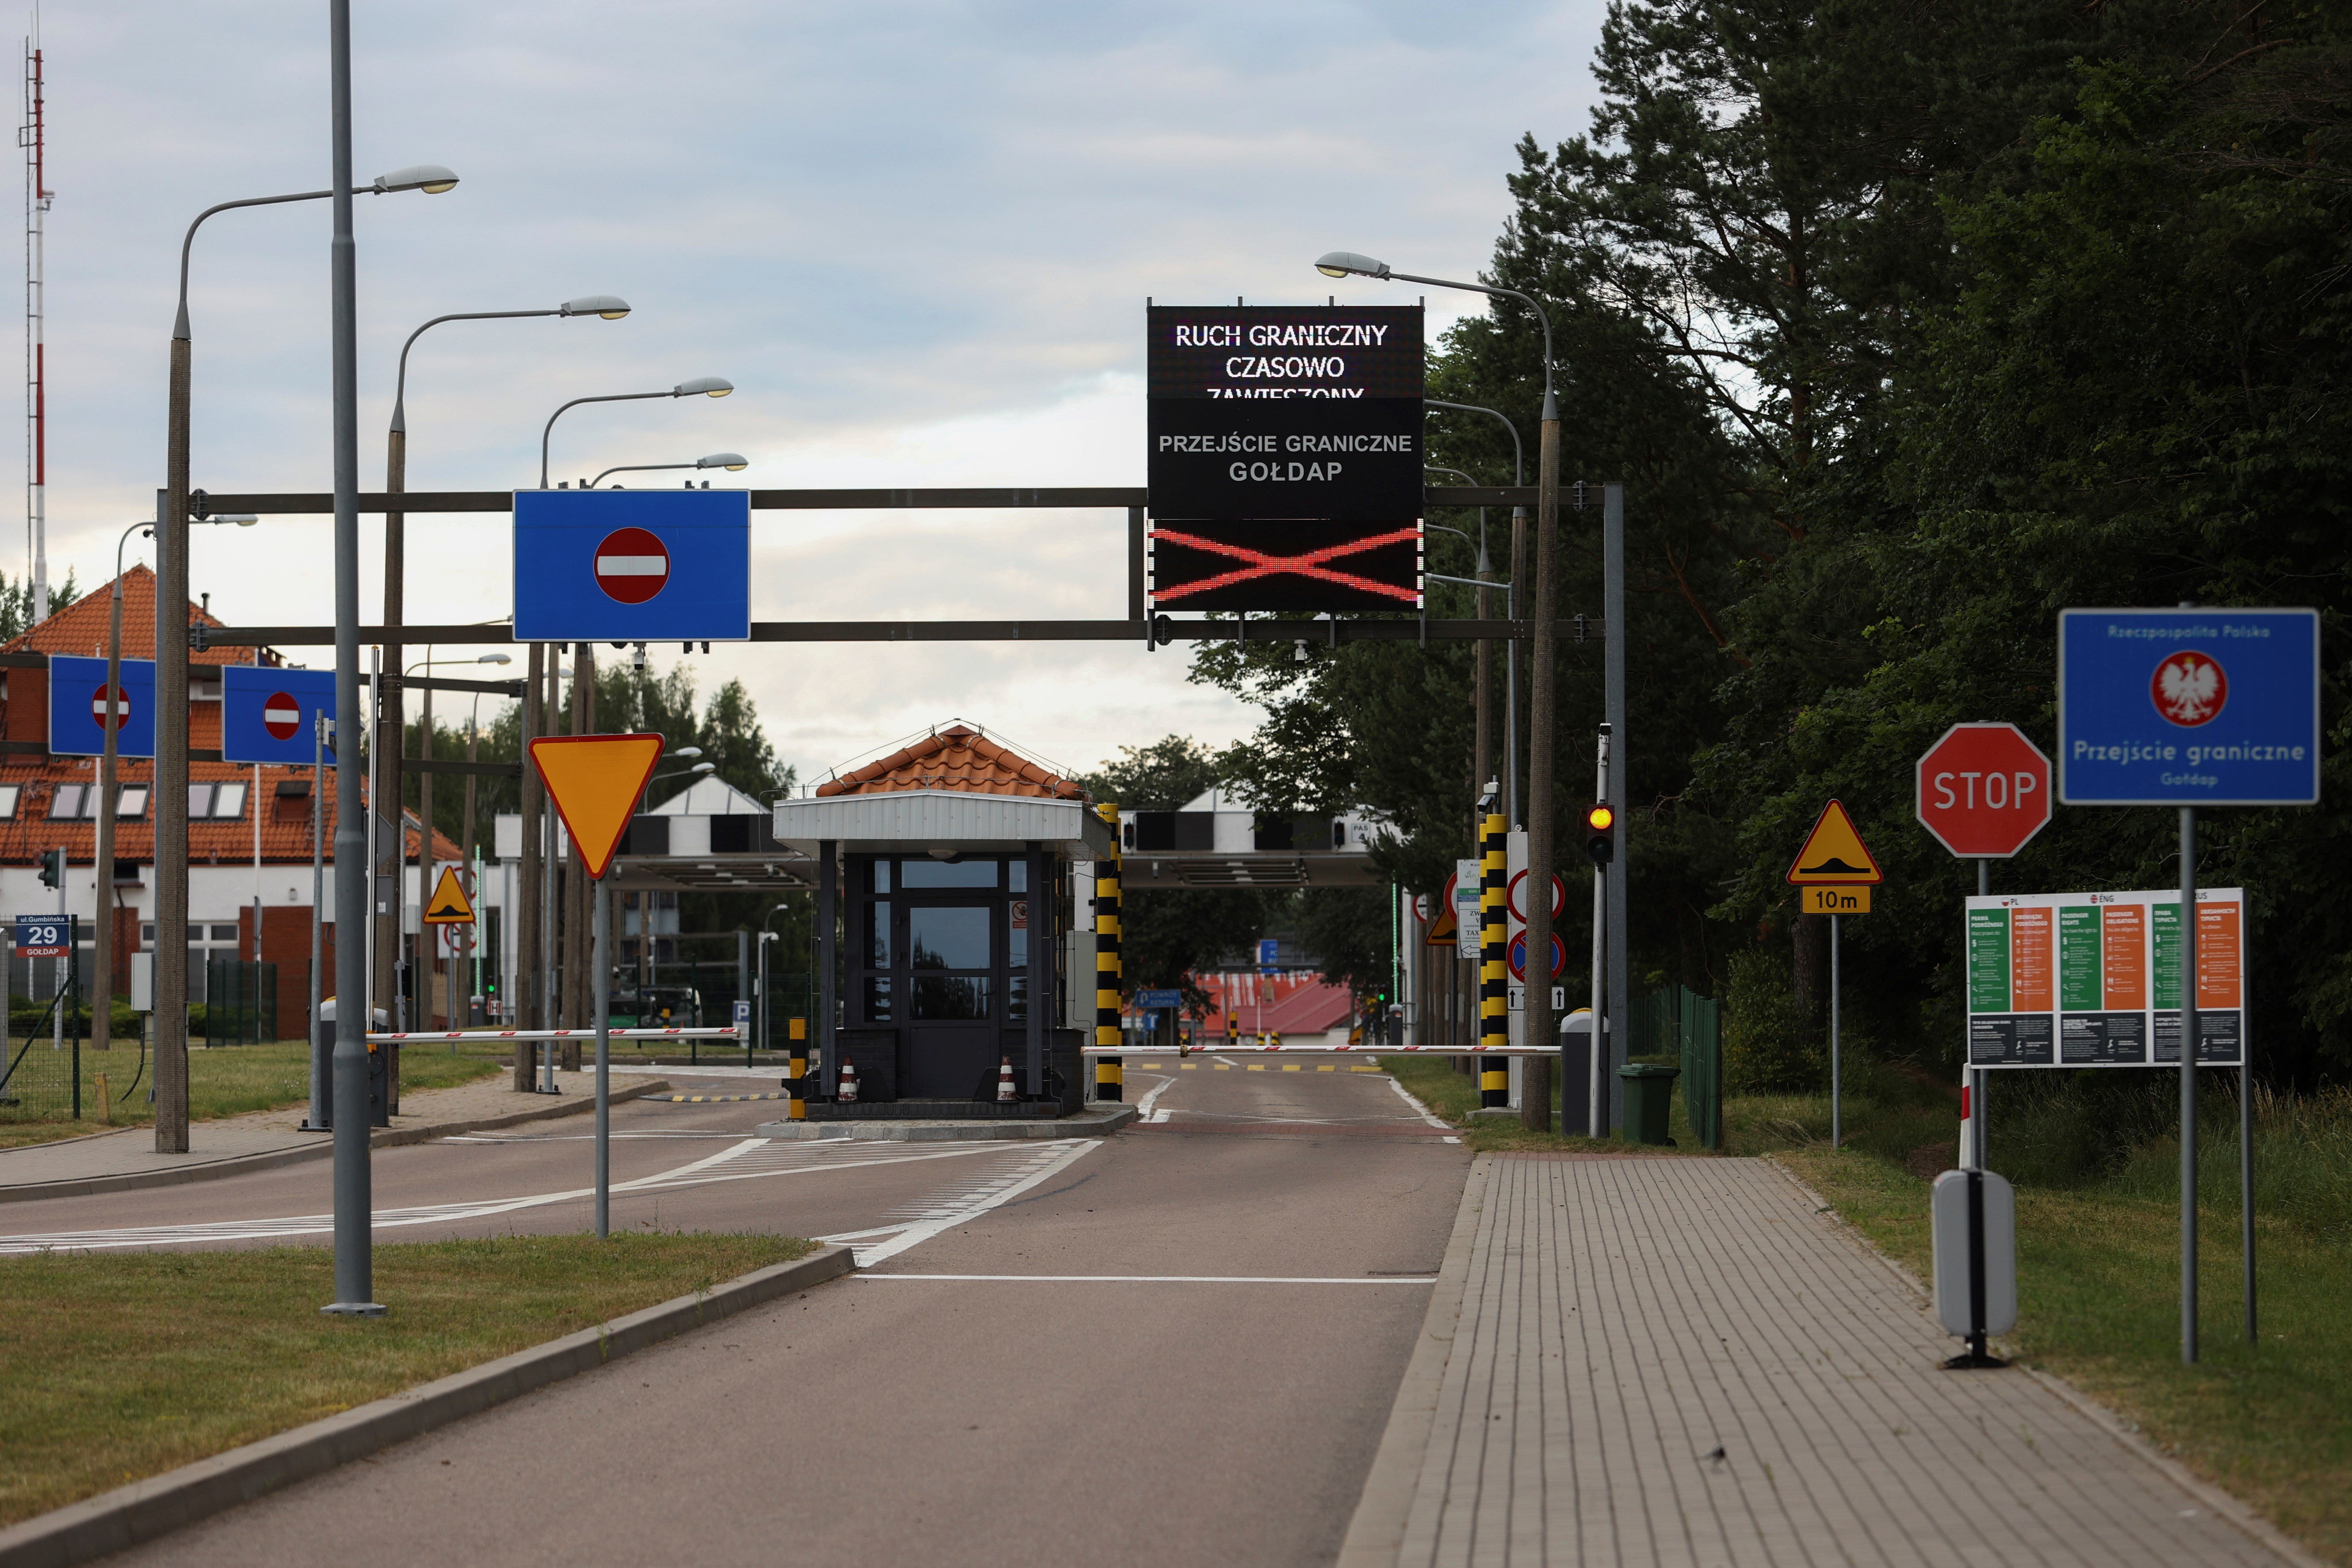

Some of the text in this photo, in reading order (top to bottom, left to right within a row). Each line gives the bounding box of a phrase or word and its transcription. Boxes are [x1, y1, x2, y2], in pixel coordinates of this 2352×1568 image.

[1176, 325, 1388, 346] RUCH GRANICZNY
[1226, 357, 1345, 378] CZASOWO
[1159, 431, 1412, 452] PRZEJŚCIE GRANICZNE
[1229, 462, 1343, 482] GOŁDAP
[2108, 624, 2270, 640] Rzeczpospolita Polska
[2074, 740, 2304, 766] Przejście graniczne
[2160, 772, 2218, 787] Gołdap
[1934, 772, 2036, 809] STOP
[1816, 891, 1857, 908] 10 m
[28, 926, 57, 944] 29
[738, 1005, 750, 1020] P
